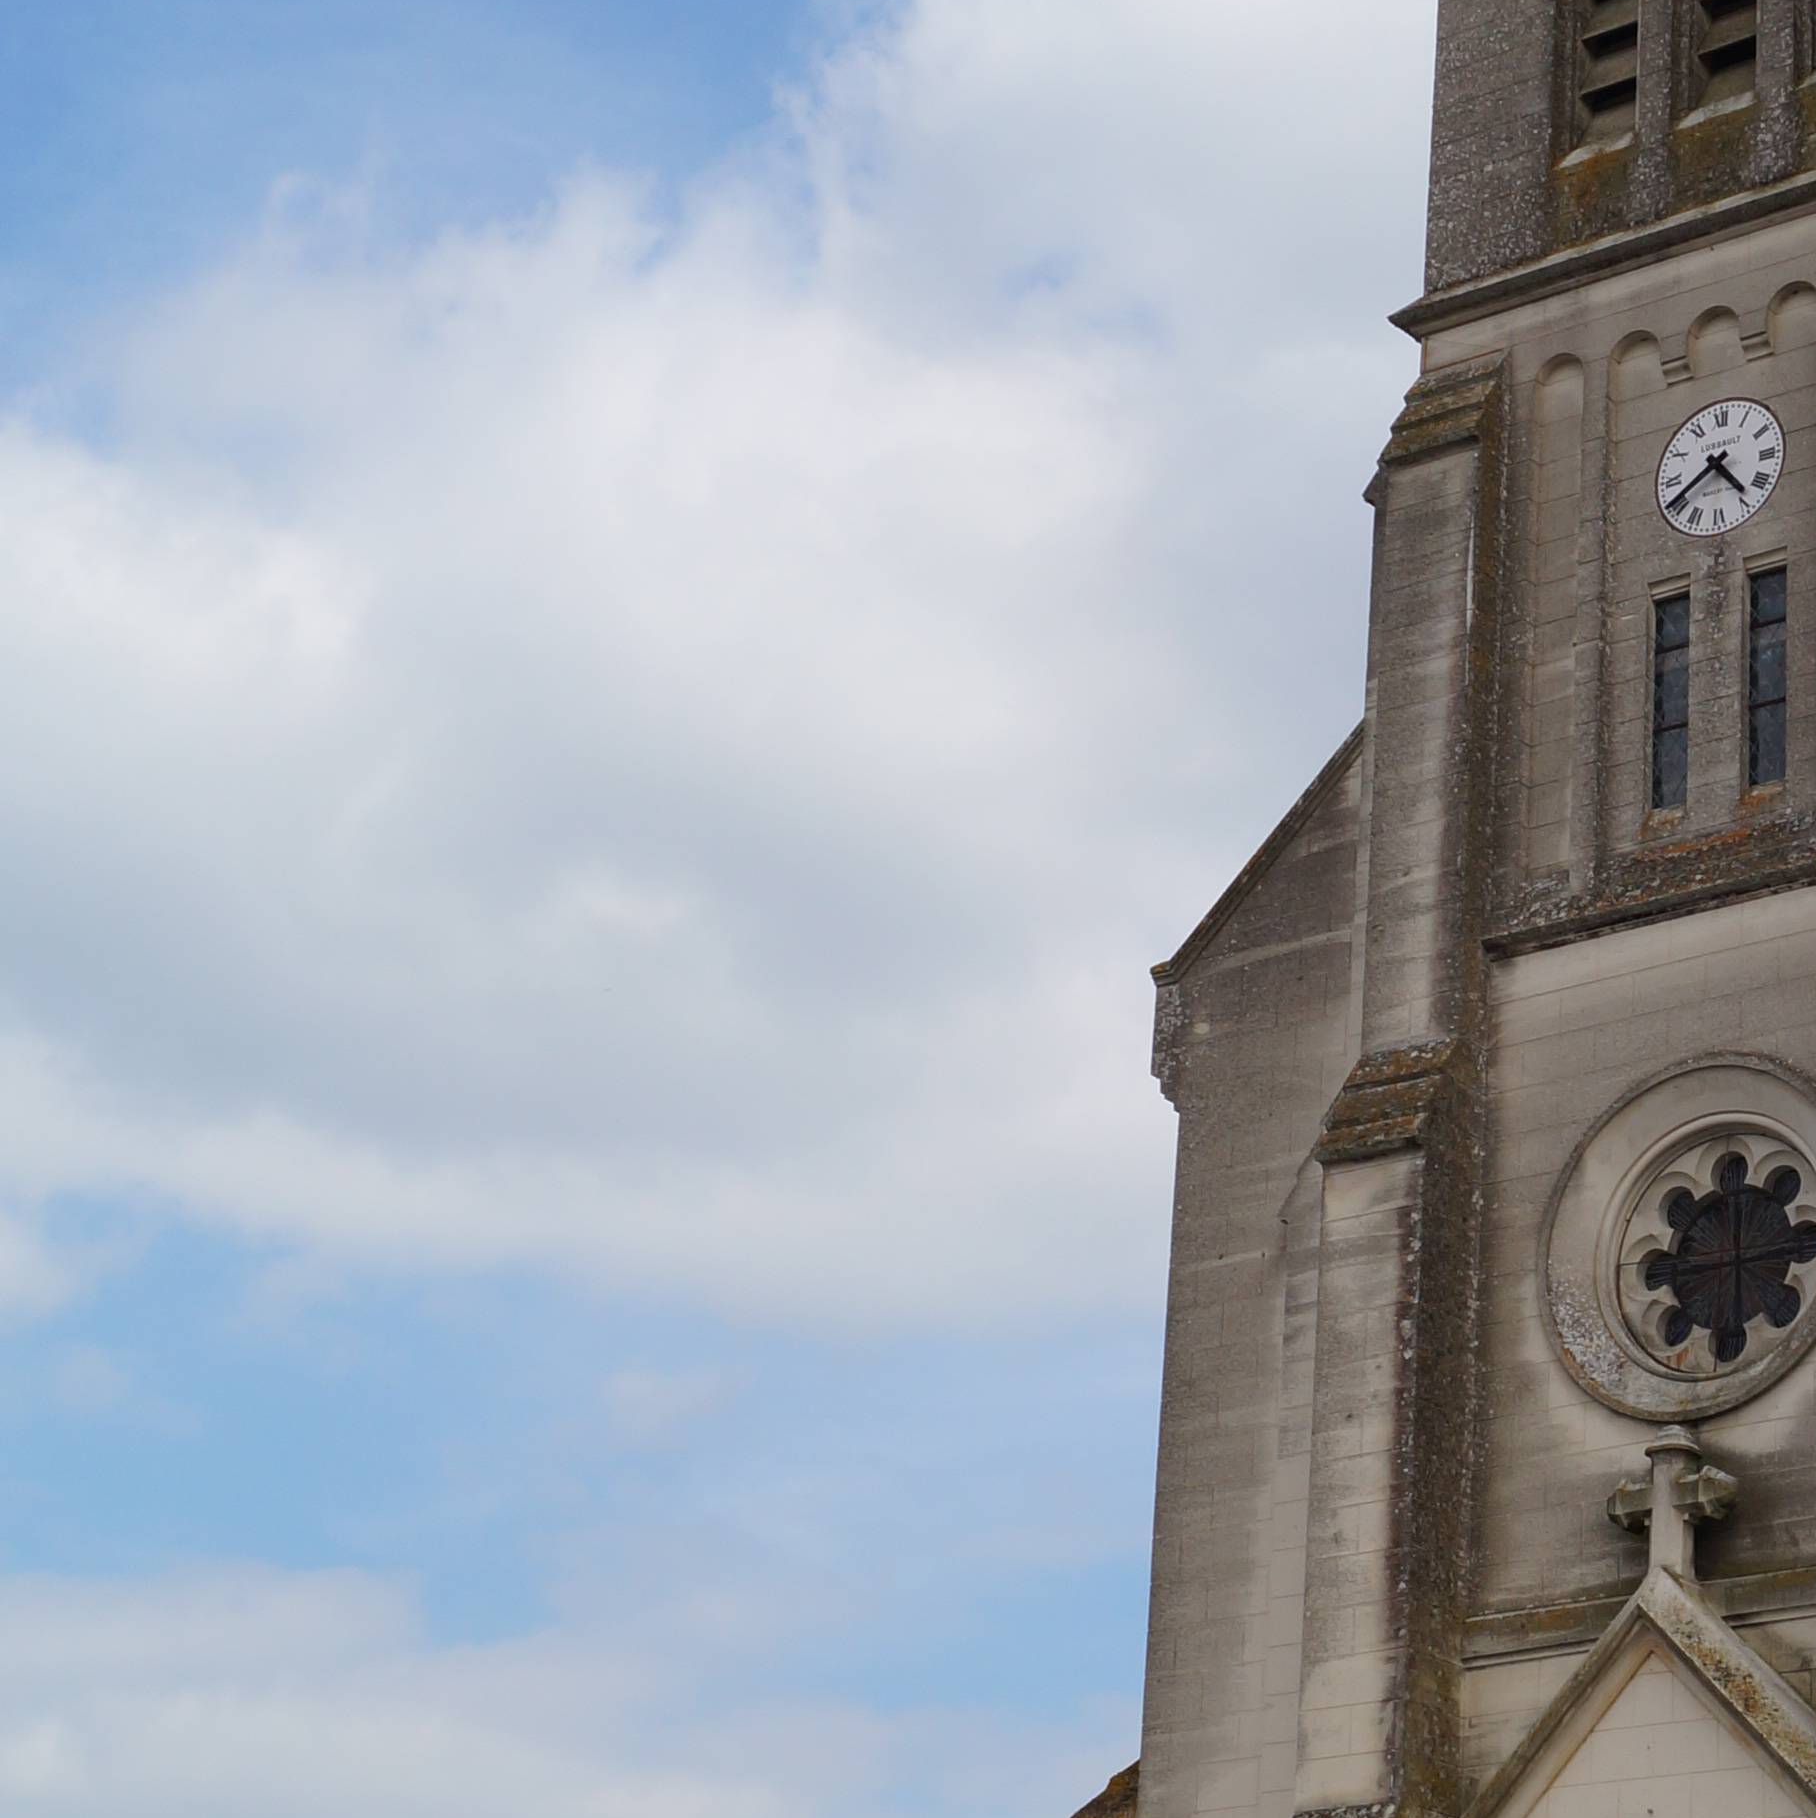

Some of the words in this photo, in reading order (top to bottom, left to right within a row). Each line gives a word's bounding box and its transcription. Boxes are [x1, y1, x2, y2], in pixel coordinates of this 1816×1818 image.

[1712, 410, 1728, 431] XII
[1752, 423, 1771, 440] II
[1758, 446, 1775, 462] III
